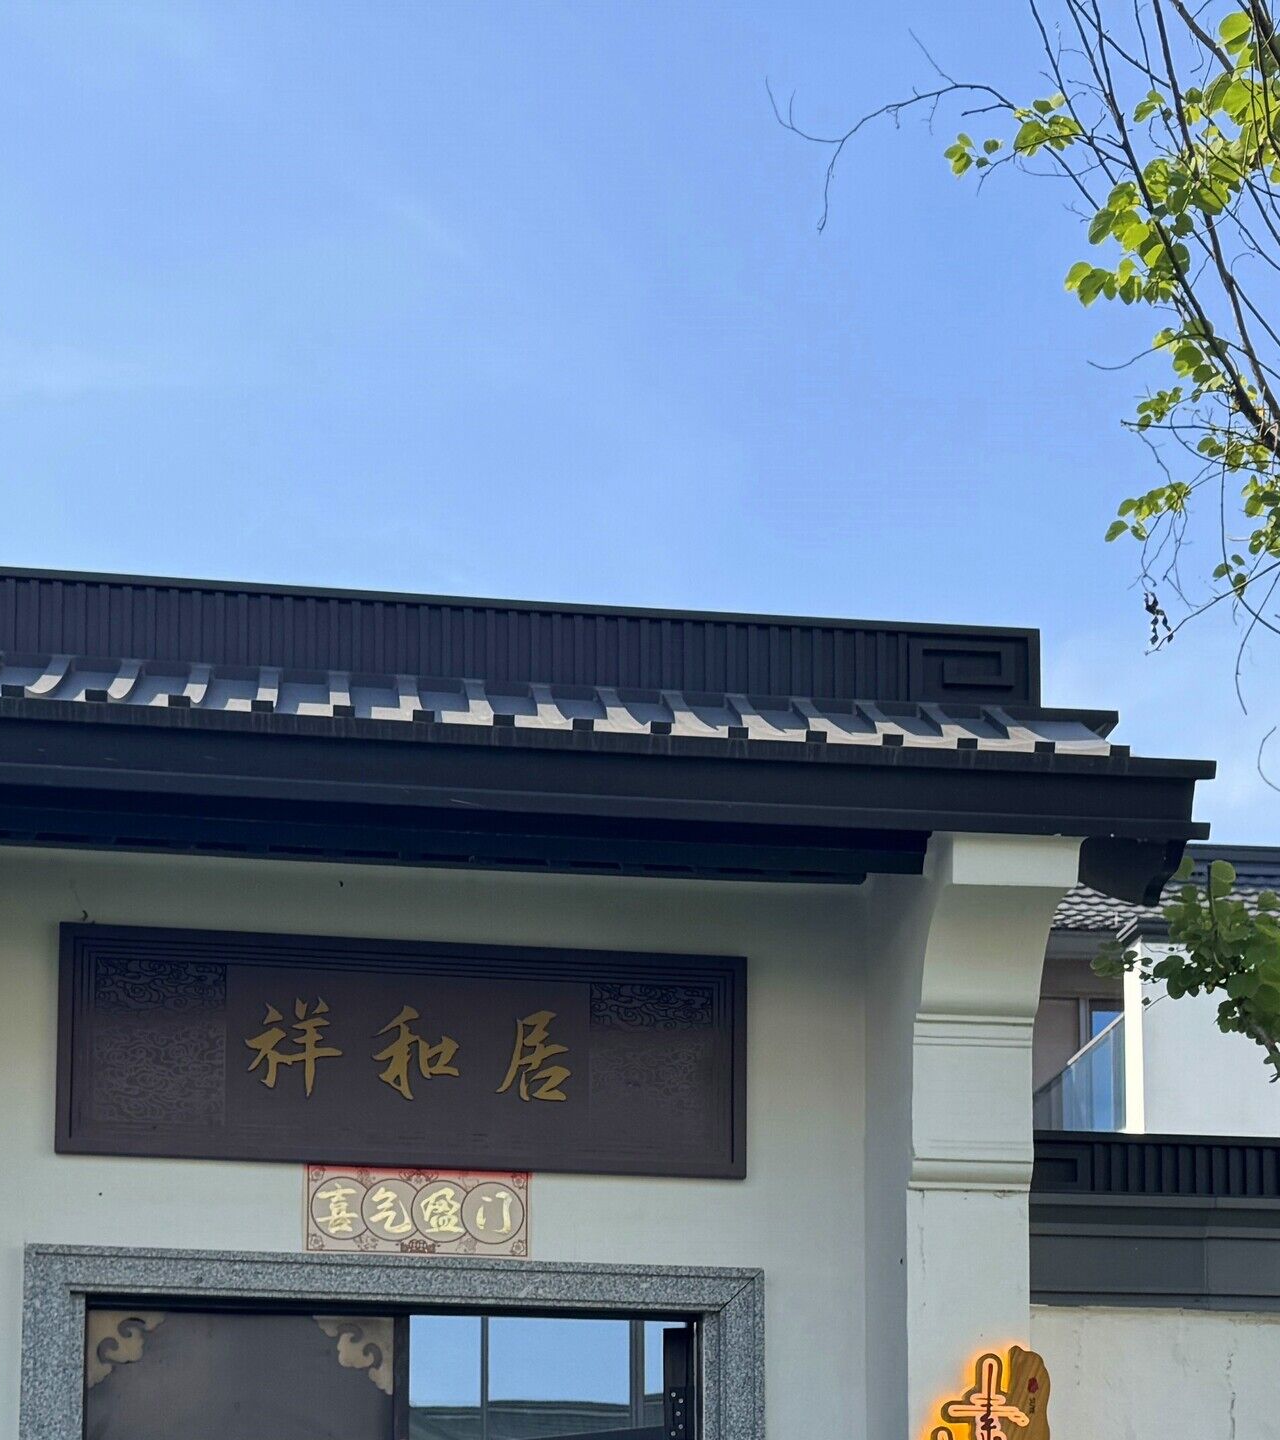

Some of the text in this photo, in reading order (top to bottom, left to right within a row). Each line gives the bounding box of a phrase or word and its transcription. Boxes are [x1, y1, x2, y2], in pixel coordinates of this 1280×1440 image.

[245, 997, 572, 1101] 祥和居
[317, 1183, 513, 1235] 喜气盈门
